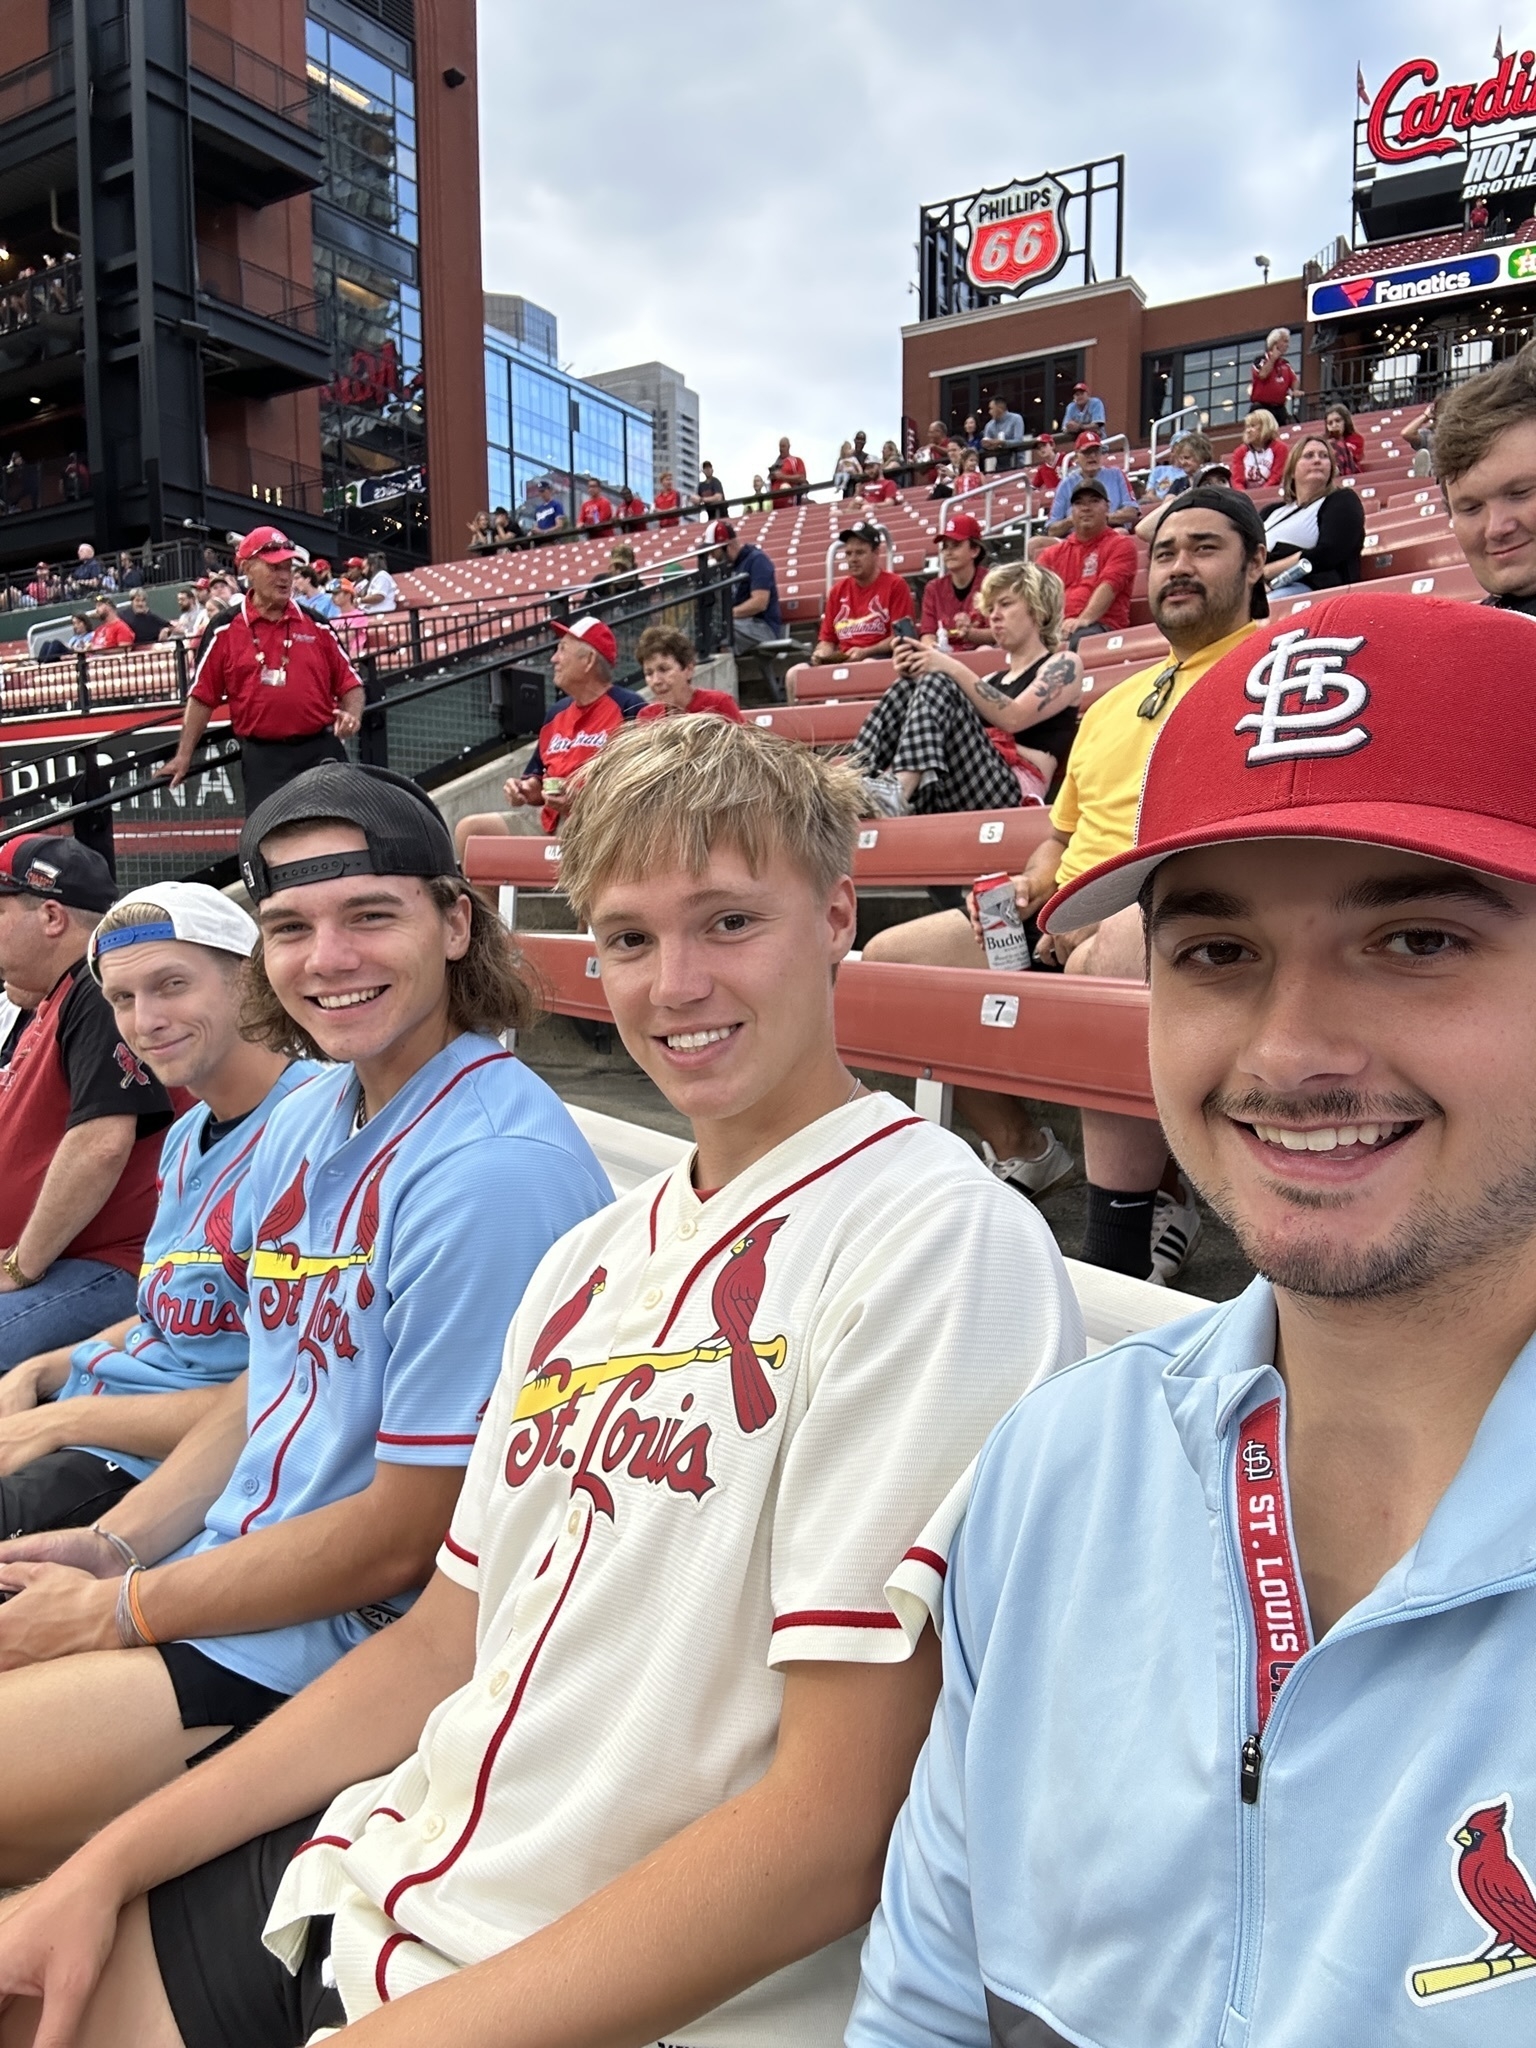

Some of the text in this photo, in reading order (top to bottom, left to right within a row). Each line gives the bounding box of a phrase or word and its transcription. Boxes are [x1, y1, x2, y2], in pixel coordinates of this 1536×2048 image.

[1368, 50, 1536, 165] Cardi
[979, 187, 1051, 223] PHILLIPS
[981, 221, 1045, 273] 66
[1375, 270, 1471, 304] Fanatics
[987, 826, 996, 840] 5
[590, 960, 597, 975] 4
[995, 1000, 1006, 1022] 7
[505, 1358, 587, 1487] St.
[1250, 1494, 1279, 1549] ST.
[1255, 1556, 1300, 1652] LOUIS
